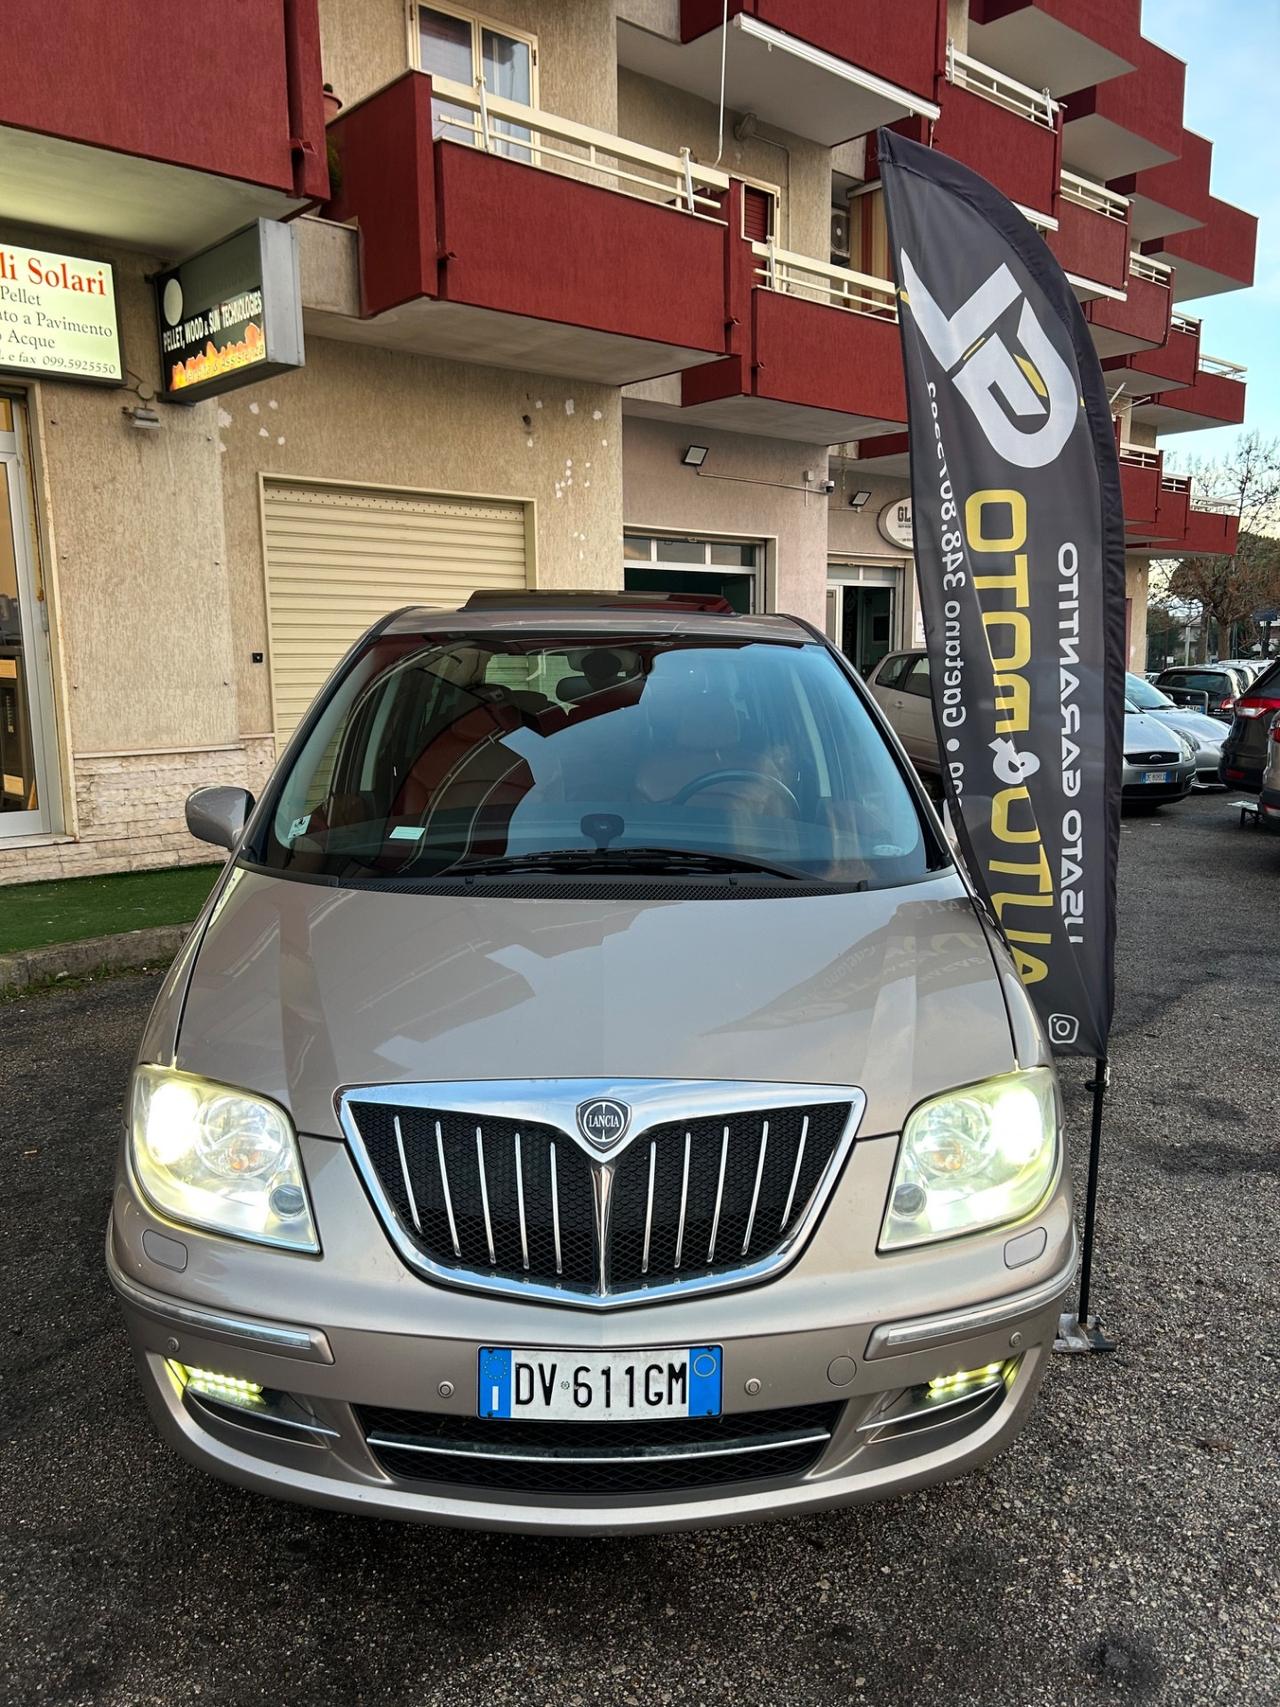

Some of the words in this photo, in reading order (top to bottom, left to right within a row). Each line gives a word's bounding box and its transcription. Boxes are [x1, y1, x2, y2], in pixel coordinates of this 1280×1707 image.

[27, 257, 106, 296] Solari
[0, 285, 42, 306] Pellet
[23, 314, 32, 325] a
[36, 311, 113, 338] Pavimento
[185, 317, 204, 343] WOOD
[208, 309, 221, 334] SUN
[8, 329, 55, 350] Acque
[19, 351, 36, 364] fax
[42, 355, 117, 375] 099.5925550
[588, 1114, 620, 1128] LANCIA
[514, 1362, 557, 1407] DV
[573, 1362, 688, 1409] 611GM
